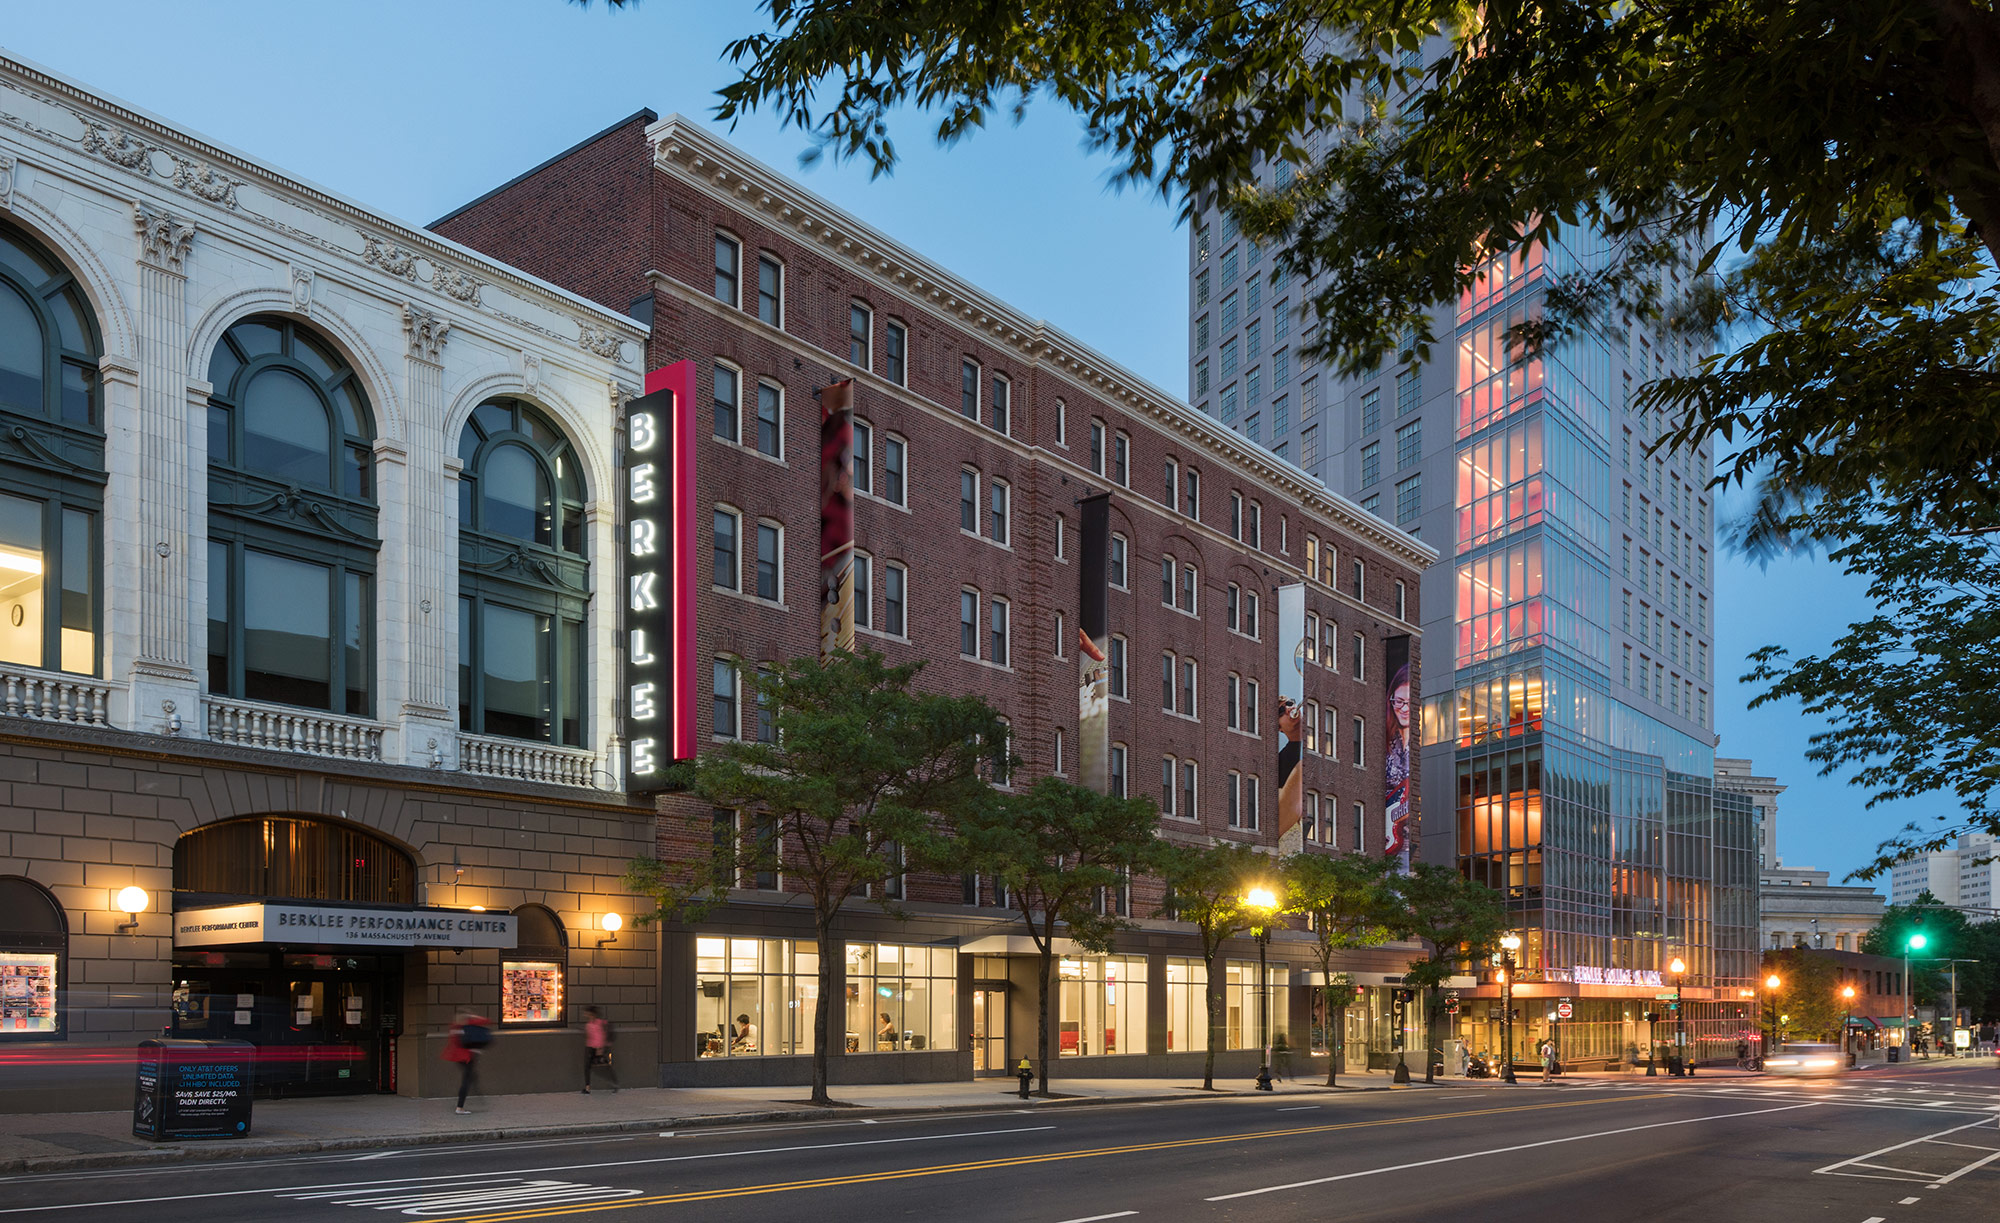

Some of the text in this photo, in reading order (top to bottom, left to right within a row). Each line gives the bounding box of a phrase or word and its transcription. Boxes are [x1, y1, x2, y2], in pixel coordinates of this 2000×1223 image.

[629, 411, 657, 775] BERKLEE
[279, 913, 507, 933] BERKLEE PERFORMANCE CENTER
[345, 931, 359, 939] 136
[361, 932, 421, 940] MASSACHUSETTS
[212, 1090, 238, 1098] $25/MO.
